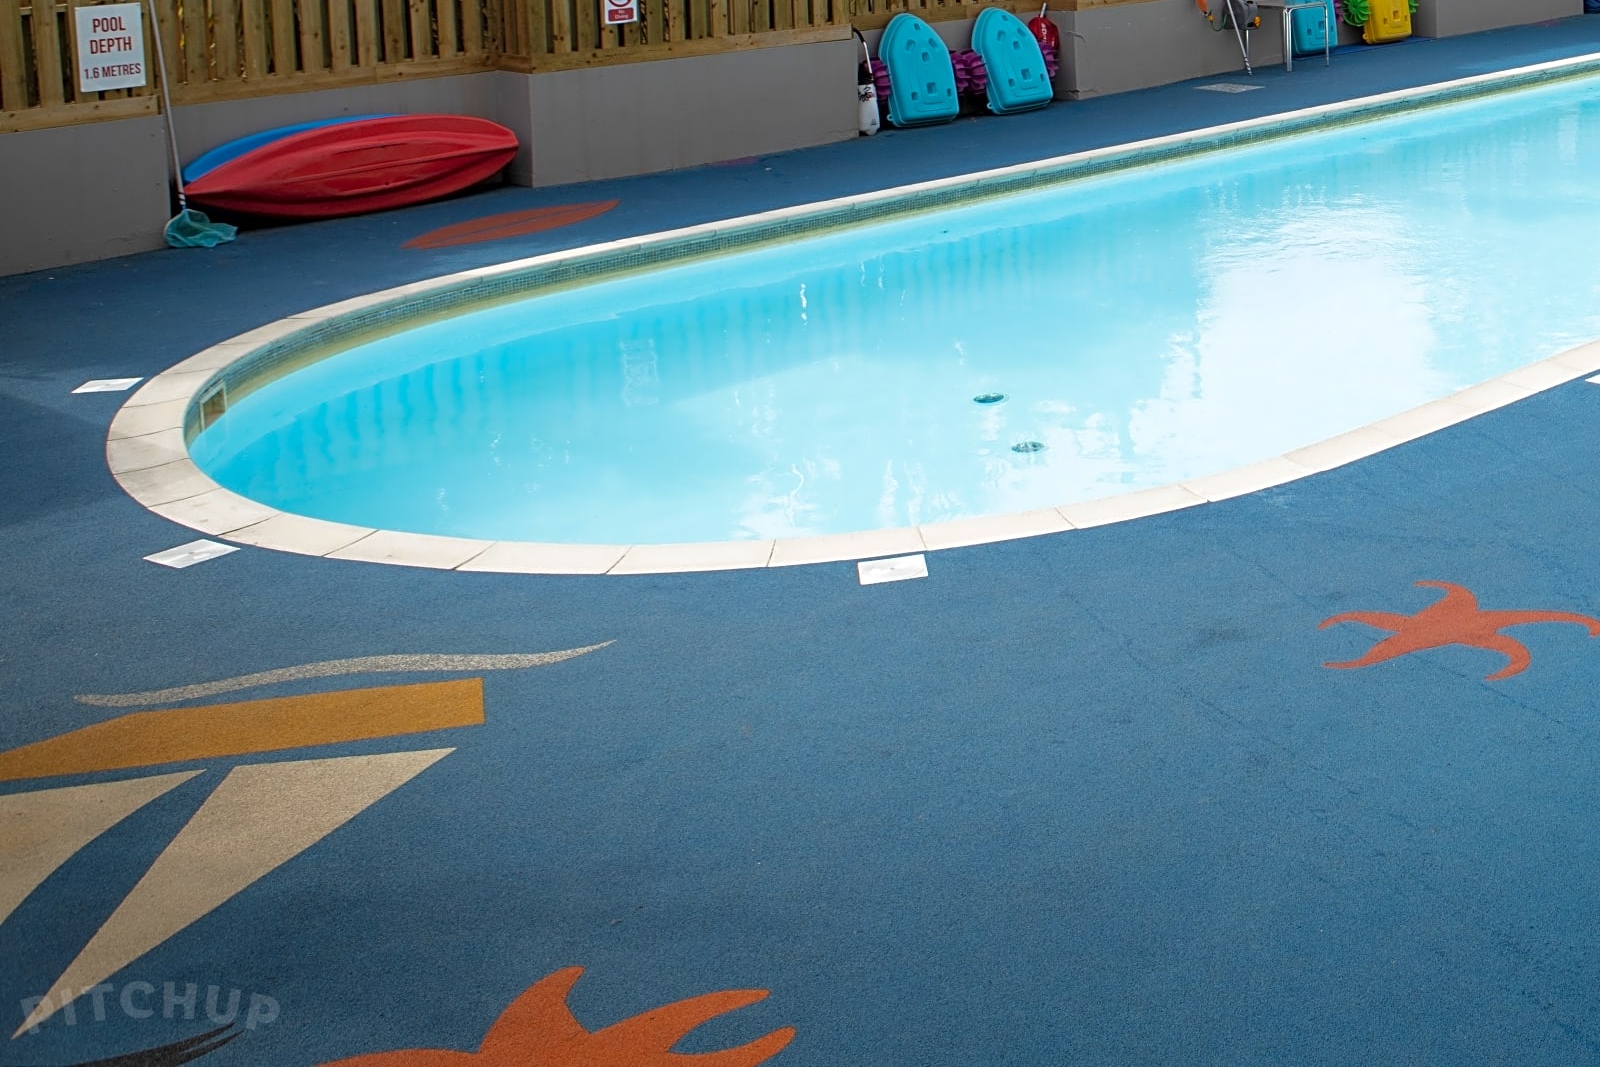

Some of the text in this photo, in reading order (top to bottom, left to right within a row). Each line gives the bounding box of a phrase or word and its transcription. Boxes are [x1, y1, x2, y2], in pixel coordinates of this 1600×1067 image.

[92, 16, 126, 33] POOL
[89, 36, 132, 54] DEPTH
[84, 62, 142, 80] 1.6 METRES
